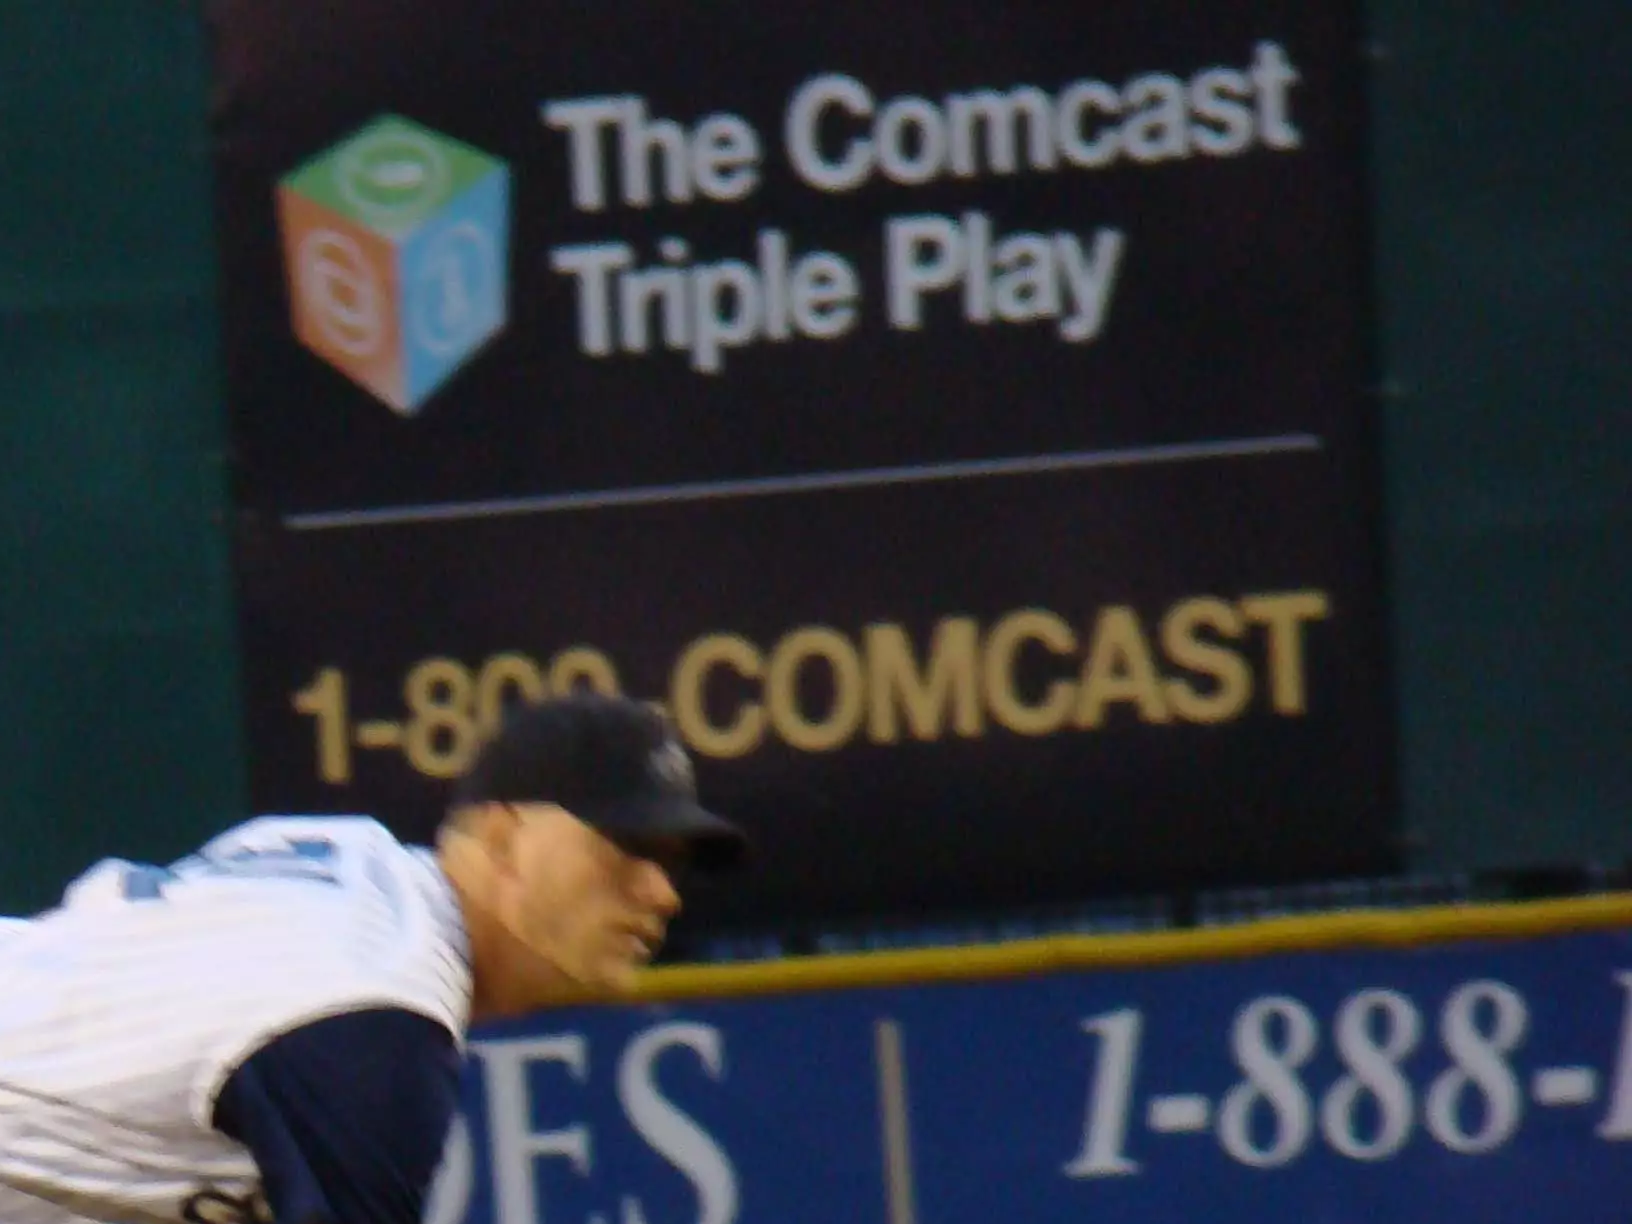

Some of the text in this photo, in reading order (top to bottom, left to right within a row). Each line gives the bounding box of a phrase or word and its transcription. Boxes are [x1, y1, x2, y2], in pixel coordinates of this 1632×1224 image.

[542, 40, 1300, 210] The Comcast
[552, 212, 1125, 373] Triple Play
[291, 590, 1327, 785] 1-80COMCAST
